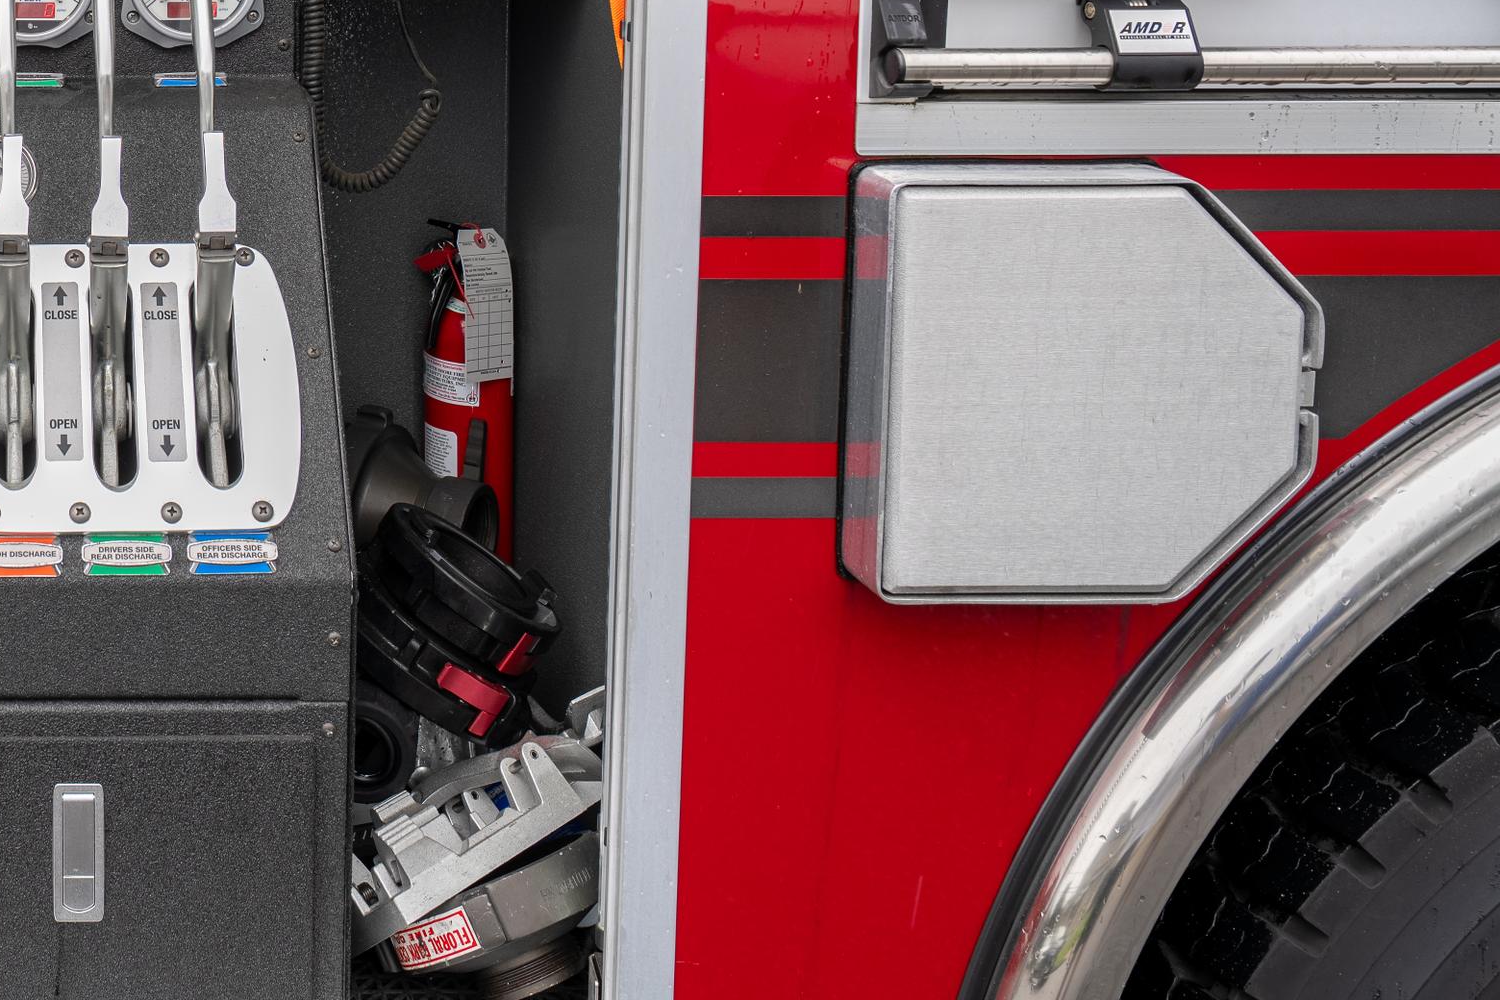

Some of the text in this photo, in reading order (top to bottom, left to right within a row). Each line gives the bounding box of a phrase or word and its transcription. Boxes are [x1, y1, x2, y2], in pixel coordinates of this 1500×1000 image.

[44, 310, 77, 320] CLOSE
[144, 310, 177, 320] CLOSE
[50, 419, 78, 429] OPEN
[152, 419, 180, 430] OPEN
[9, 550, 57, 558] DISCHARGE
[427, 926, 471, 955] FLORAL
